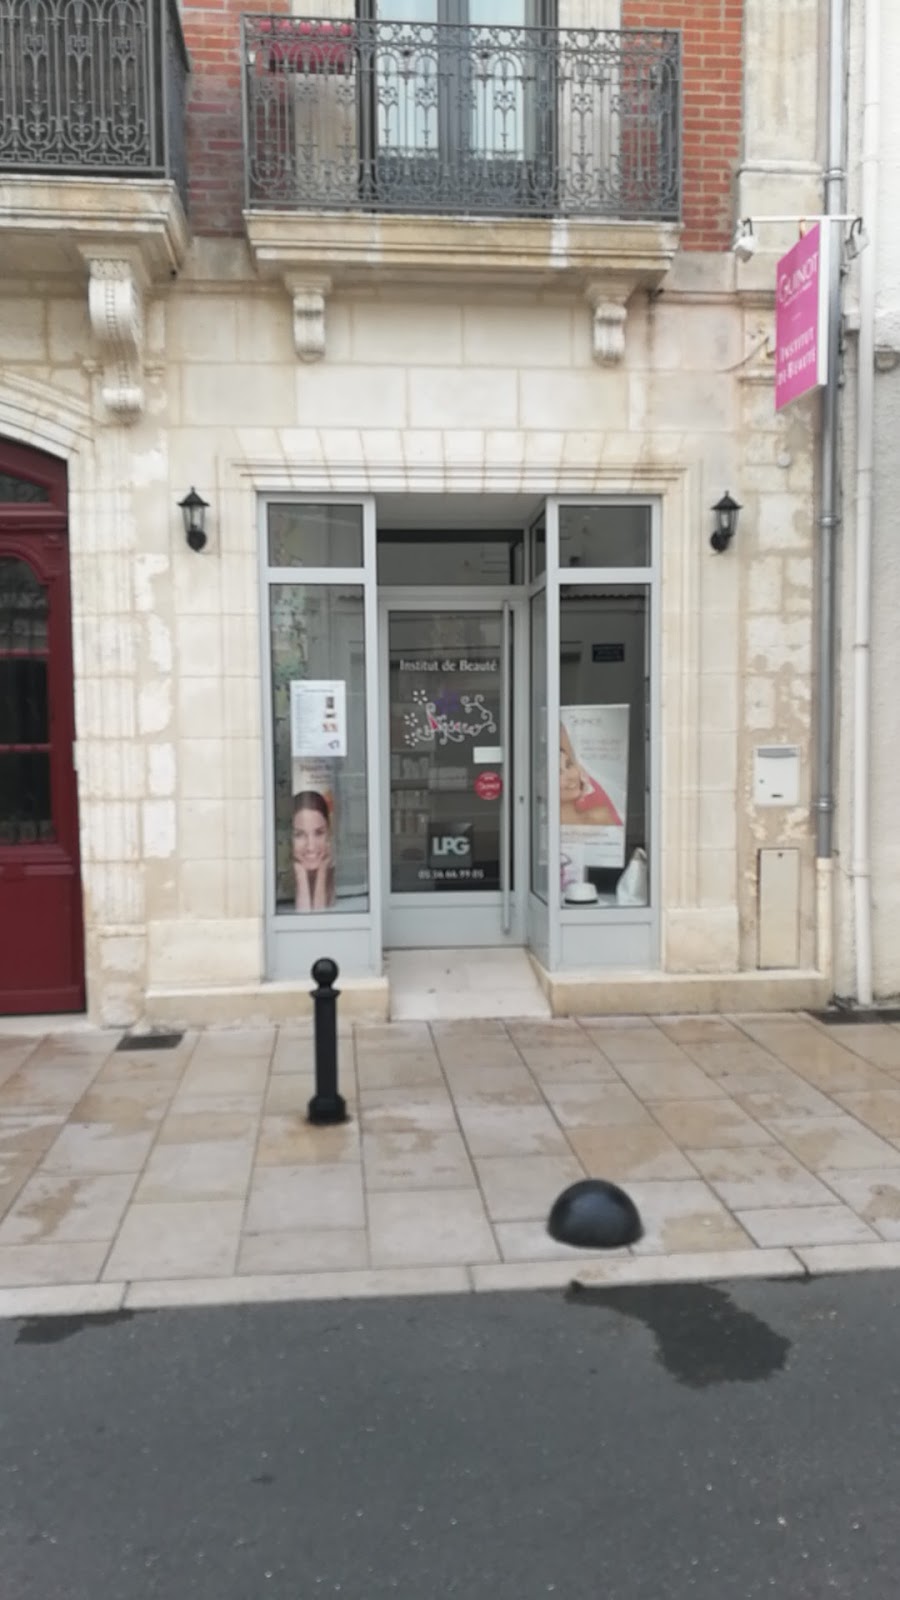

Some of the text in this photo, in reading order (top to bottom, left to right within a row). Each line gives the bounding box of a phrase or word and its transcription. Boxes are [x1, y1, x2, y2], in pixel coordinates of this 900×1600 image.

[778, 253, 819, 303] GUINOT
[780, 327, 815, 363] INSTITUT
[400, 659, 498, 672] Institut de Beauté
[432, 836, 471, 856] LPG
